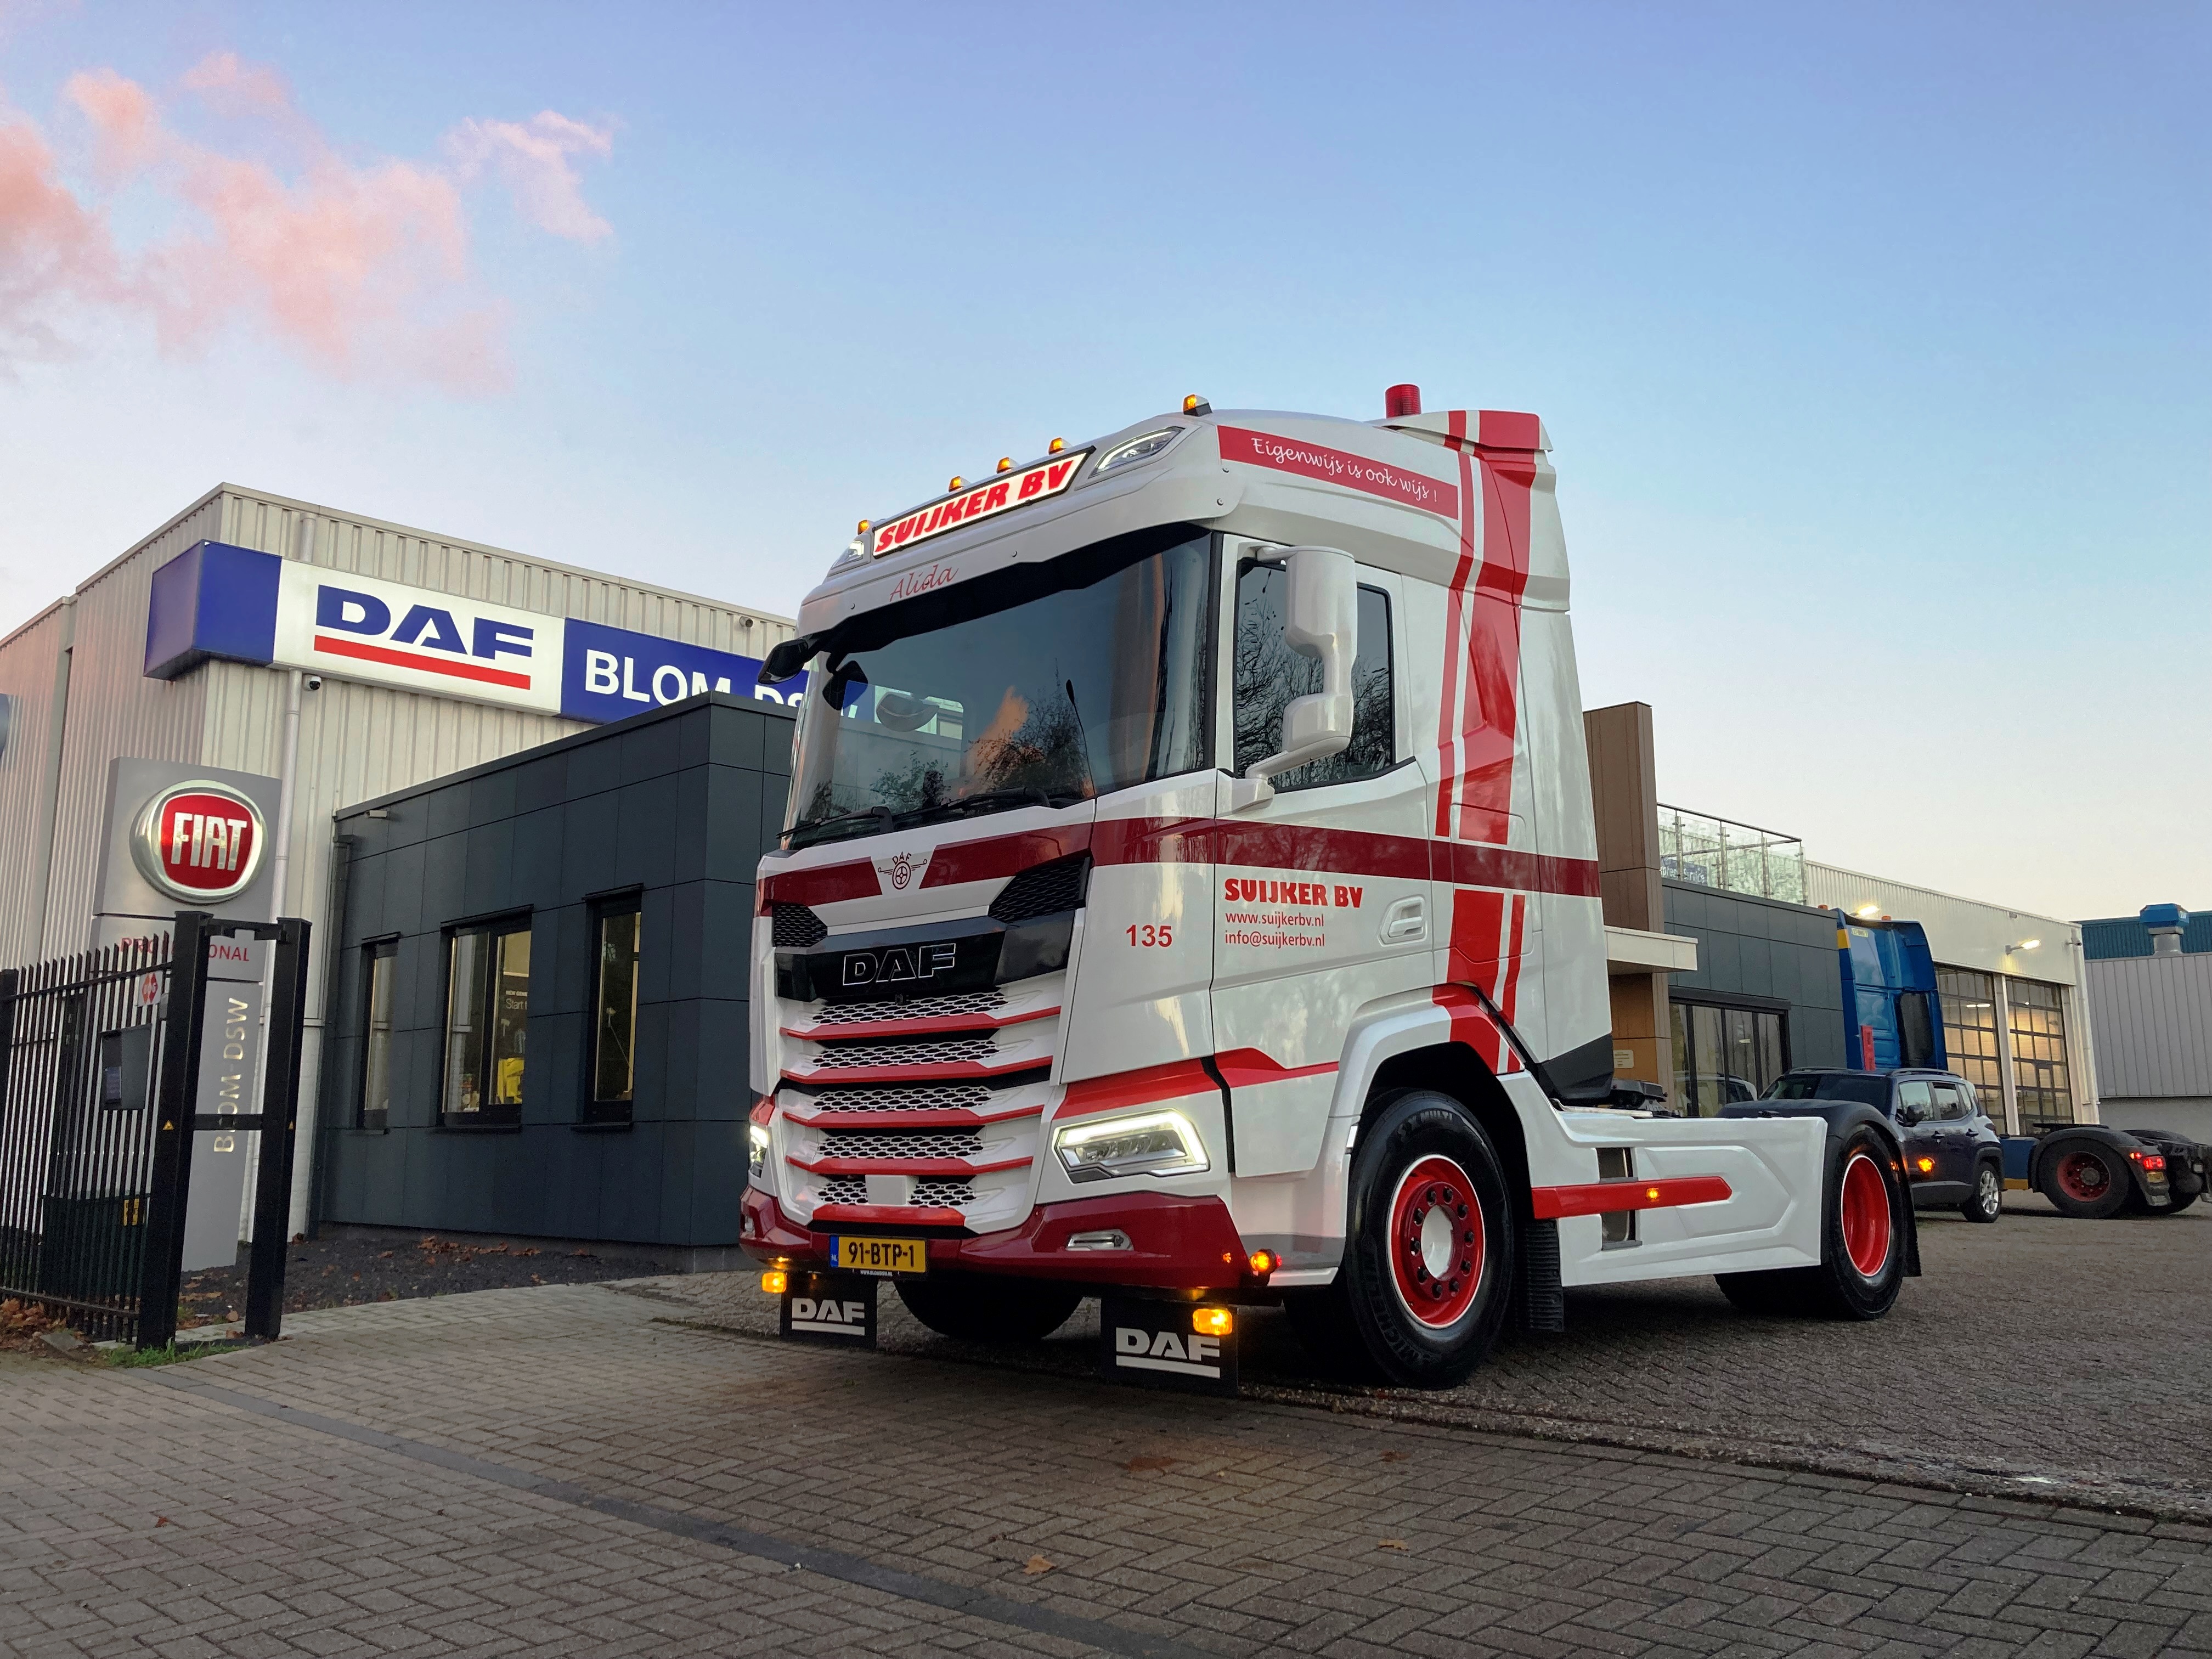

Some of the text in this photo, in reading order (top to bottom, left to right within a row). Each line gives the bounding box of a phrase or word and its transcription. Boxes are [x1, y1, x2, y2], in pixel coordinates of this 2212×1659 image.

[1251, 437, 1344, 476] Eigenwijs
[1347, 460, 1363, 478] is
[1365, 467, 1398, 487] ook
[874, 459, 1074, 552] SUIJKER BV
[889, 563, 960, 602] Alida
[315, 584, 534, 660] DAF
[171, 811, 247, 871] FIAT
[891, 851, 912, 865] DAF
[1224, 878, 1364, 909] SUIJKER BV
[1126, 924, 1172, 947] 135
[1225, 911, 1325, 928] www.suijkerbv.nl
[1224, 929, 1325, 949] info@suijkerbv.nl
[842, 943, 956, 986] DAF
[848, 1241, 915, 1268] 91-BTP-1
[791, 1297, 865, 1323] DAF
[1116, 1327, 1220, 1362] DAF
